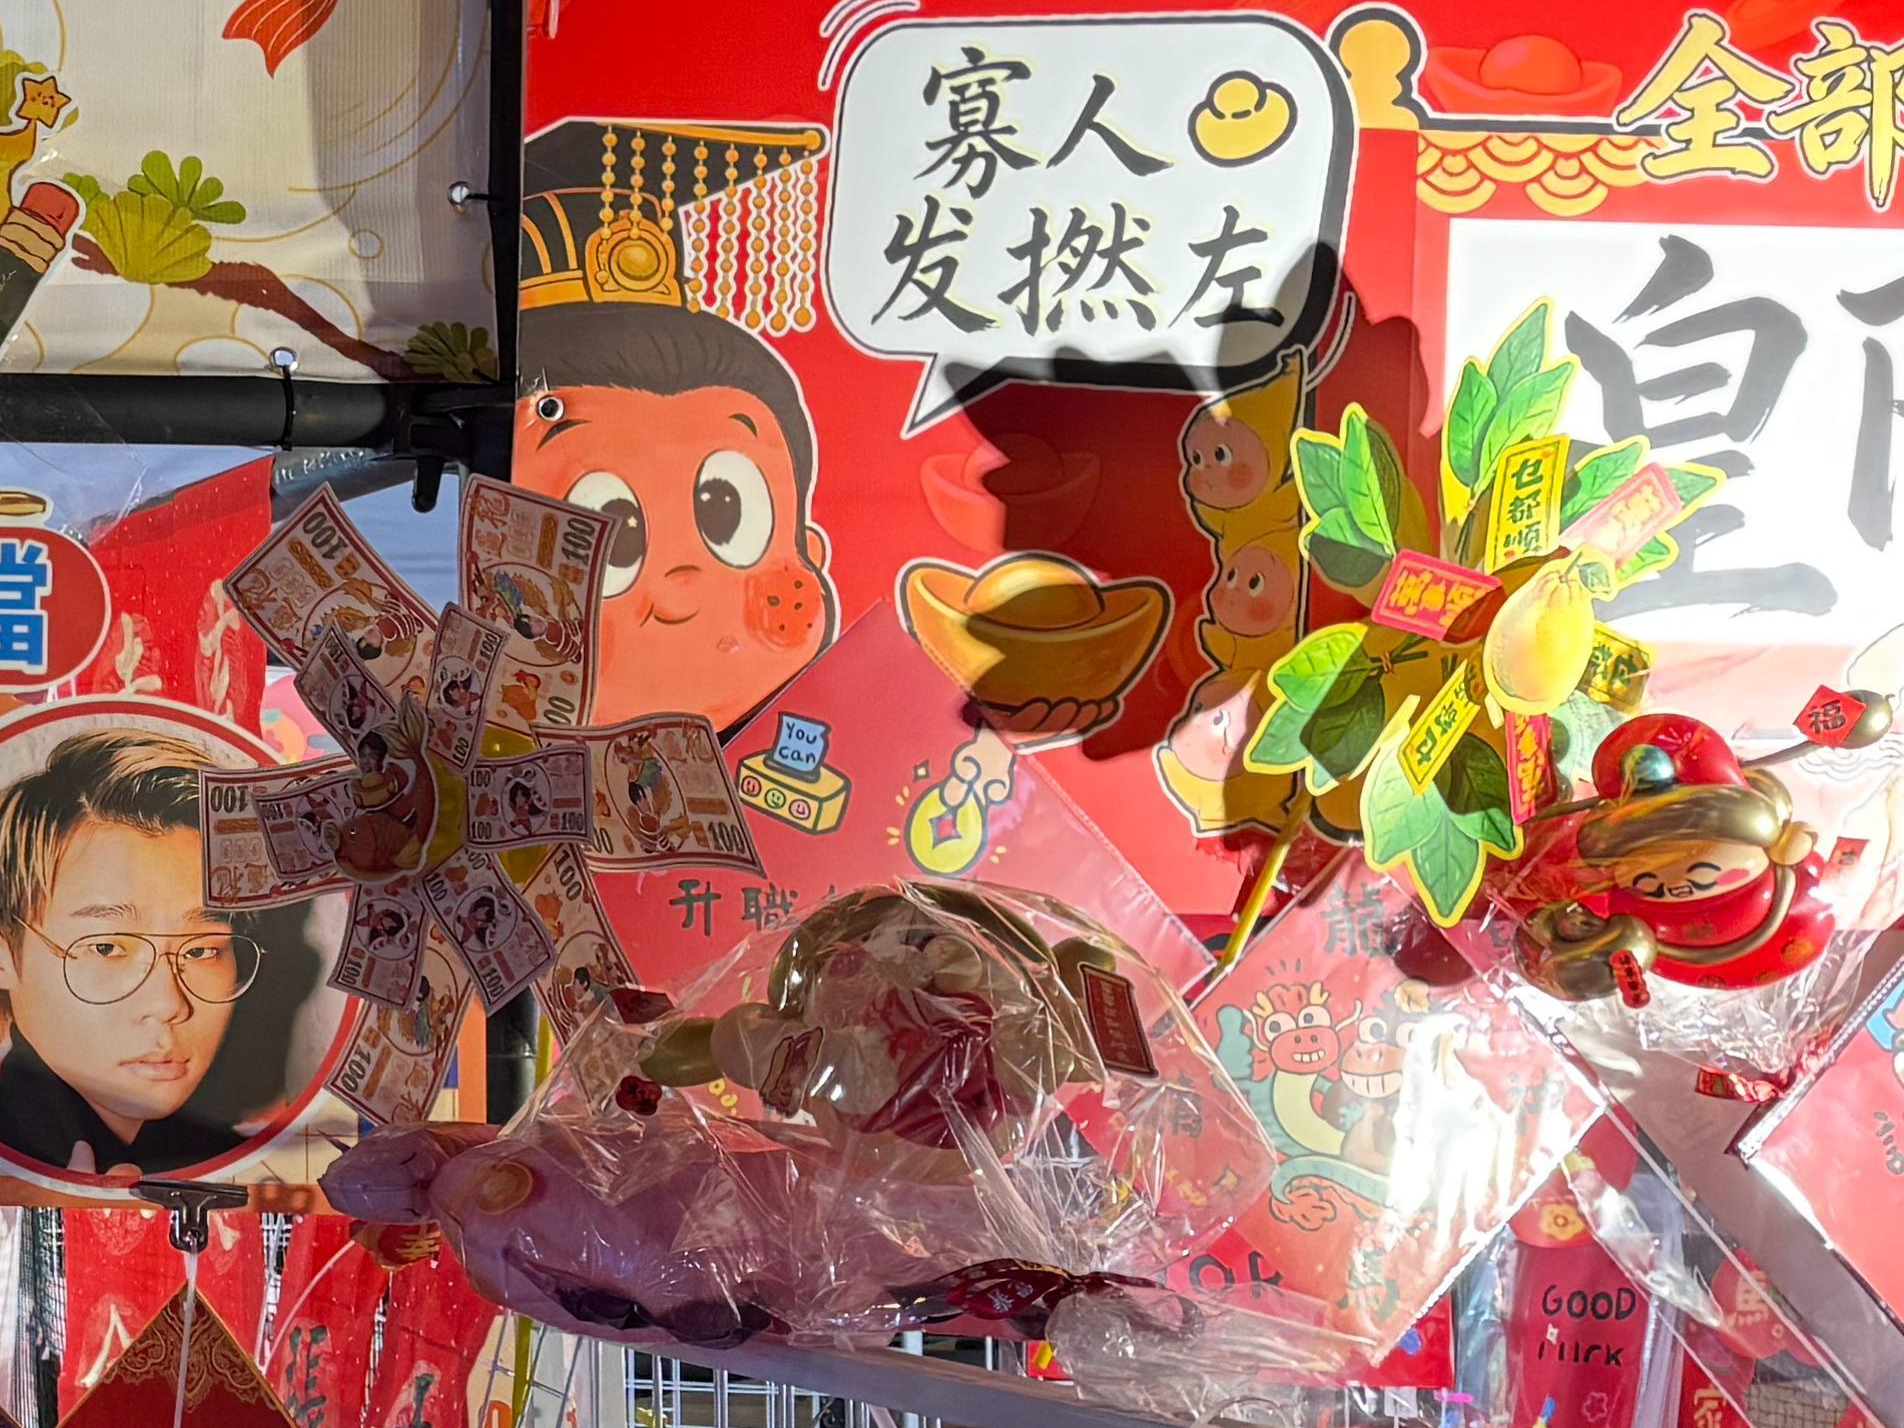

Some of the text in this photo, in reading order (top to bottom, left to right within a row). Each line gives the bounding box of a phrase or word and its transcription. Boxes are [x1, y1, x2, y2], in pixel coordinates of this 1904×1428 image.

[920, 48, 1173, 204] 寡人
[784, 721, 818, 746] You
[778, 746, 817, 765] can
[1542, 1285, 1637, 1321] GOOD
